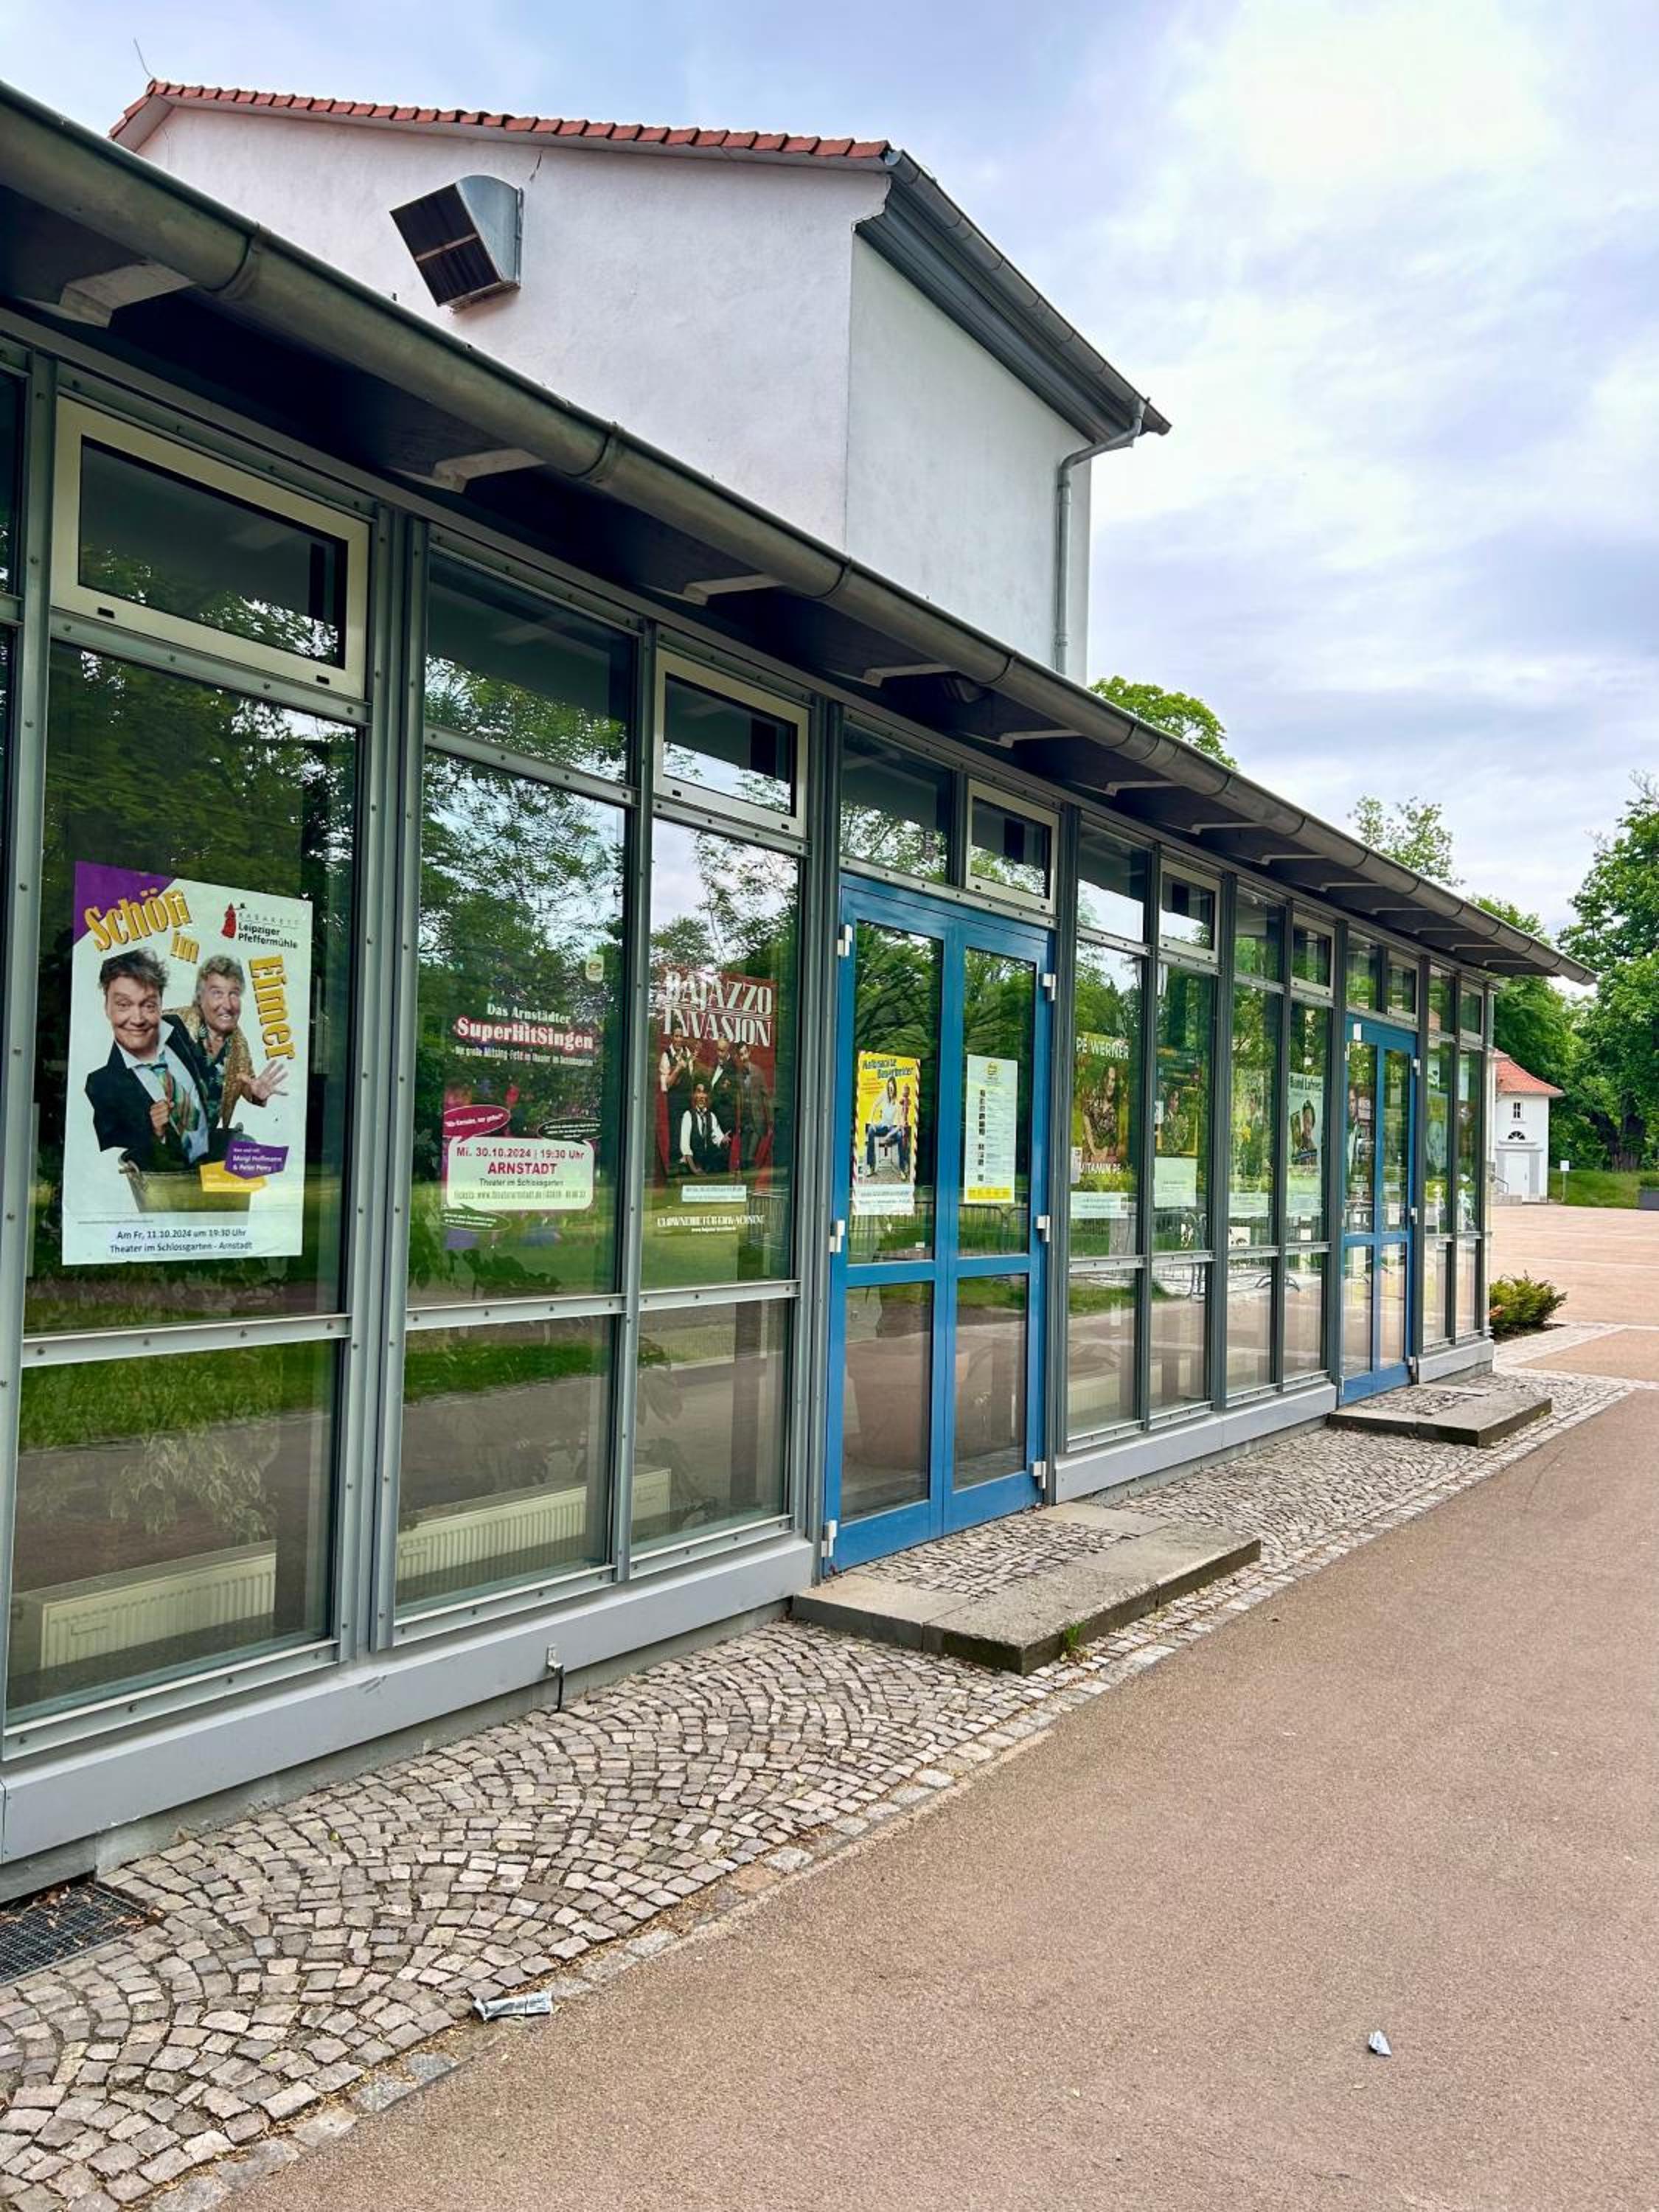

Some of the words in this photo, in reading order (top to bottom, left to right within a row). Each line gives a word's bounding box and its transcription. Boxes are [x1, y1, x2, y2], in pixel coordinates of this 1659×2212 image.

[84, 887, 192, 951] Schön
[238, 922, 280, 936] Leipziger
[170, 931, 199, 964] im
[238, 933, 298, 949] Pfeffermühle
[249, 954, 295, 1060] Eimer
[487, 1003, 509, 1017] Das
[512, 1006, 571, 1024] Arnstädter
[457, 1017, 594, 1051] SuperHitSingen
[664, 1007, 772, 1047] INVASION
[1091, 1039, 1130, 1060] WERNER
[456, 1147, 472, 1157] Mi.
[476, 1147, 532, 1158] 30.10.2024
[541, 1149, 566, 1159] 19:30
[568, 1150, 585, 1159] Uhr
[487, 1162, 558, 1175] ARNSTADT
[479, 1178, 505, 1186] Theater
[507, 1178, 515, 1186] im
[117, 1231, 131, 1239] Am
[133, 1231, 145, 1240] Fr,
[147, 1229, 191, 1239] 11.10.2024
[209, 1229, 231, 1237] 19:30
[232, 1228, 247, 1237] Uhr
[110, 1245, 142, 1253] Theater
[144, 1243, 155, 1252] im
[157, 1242, 212, 1253] Schlossgarten
[219, 1242, 252, 1251] Arnstadt
